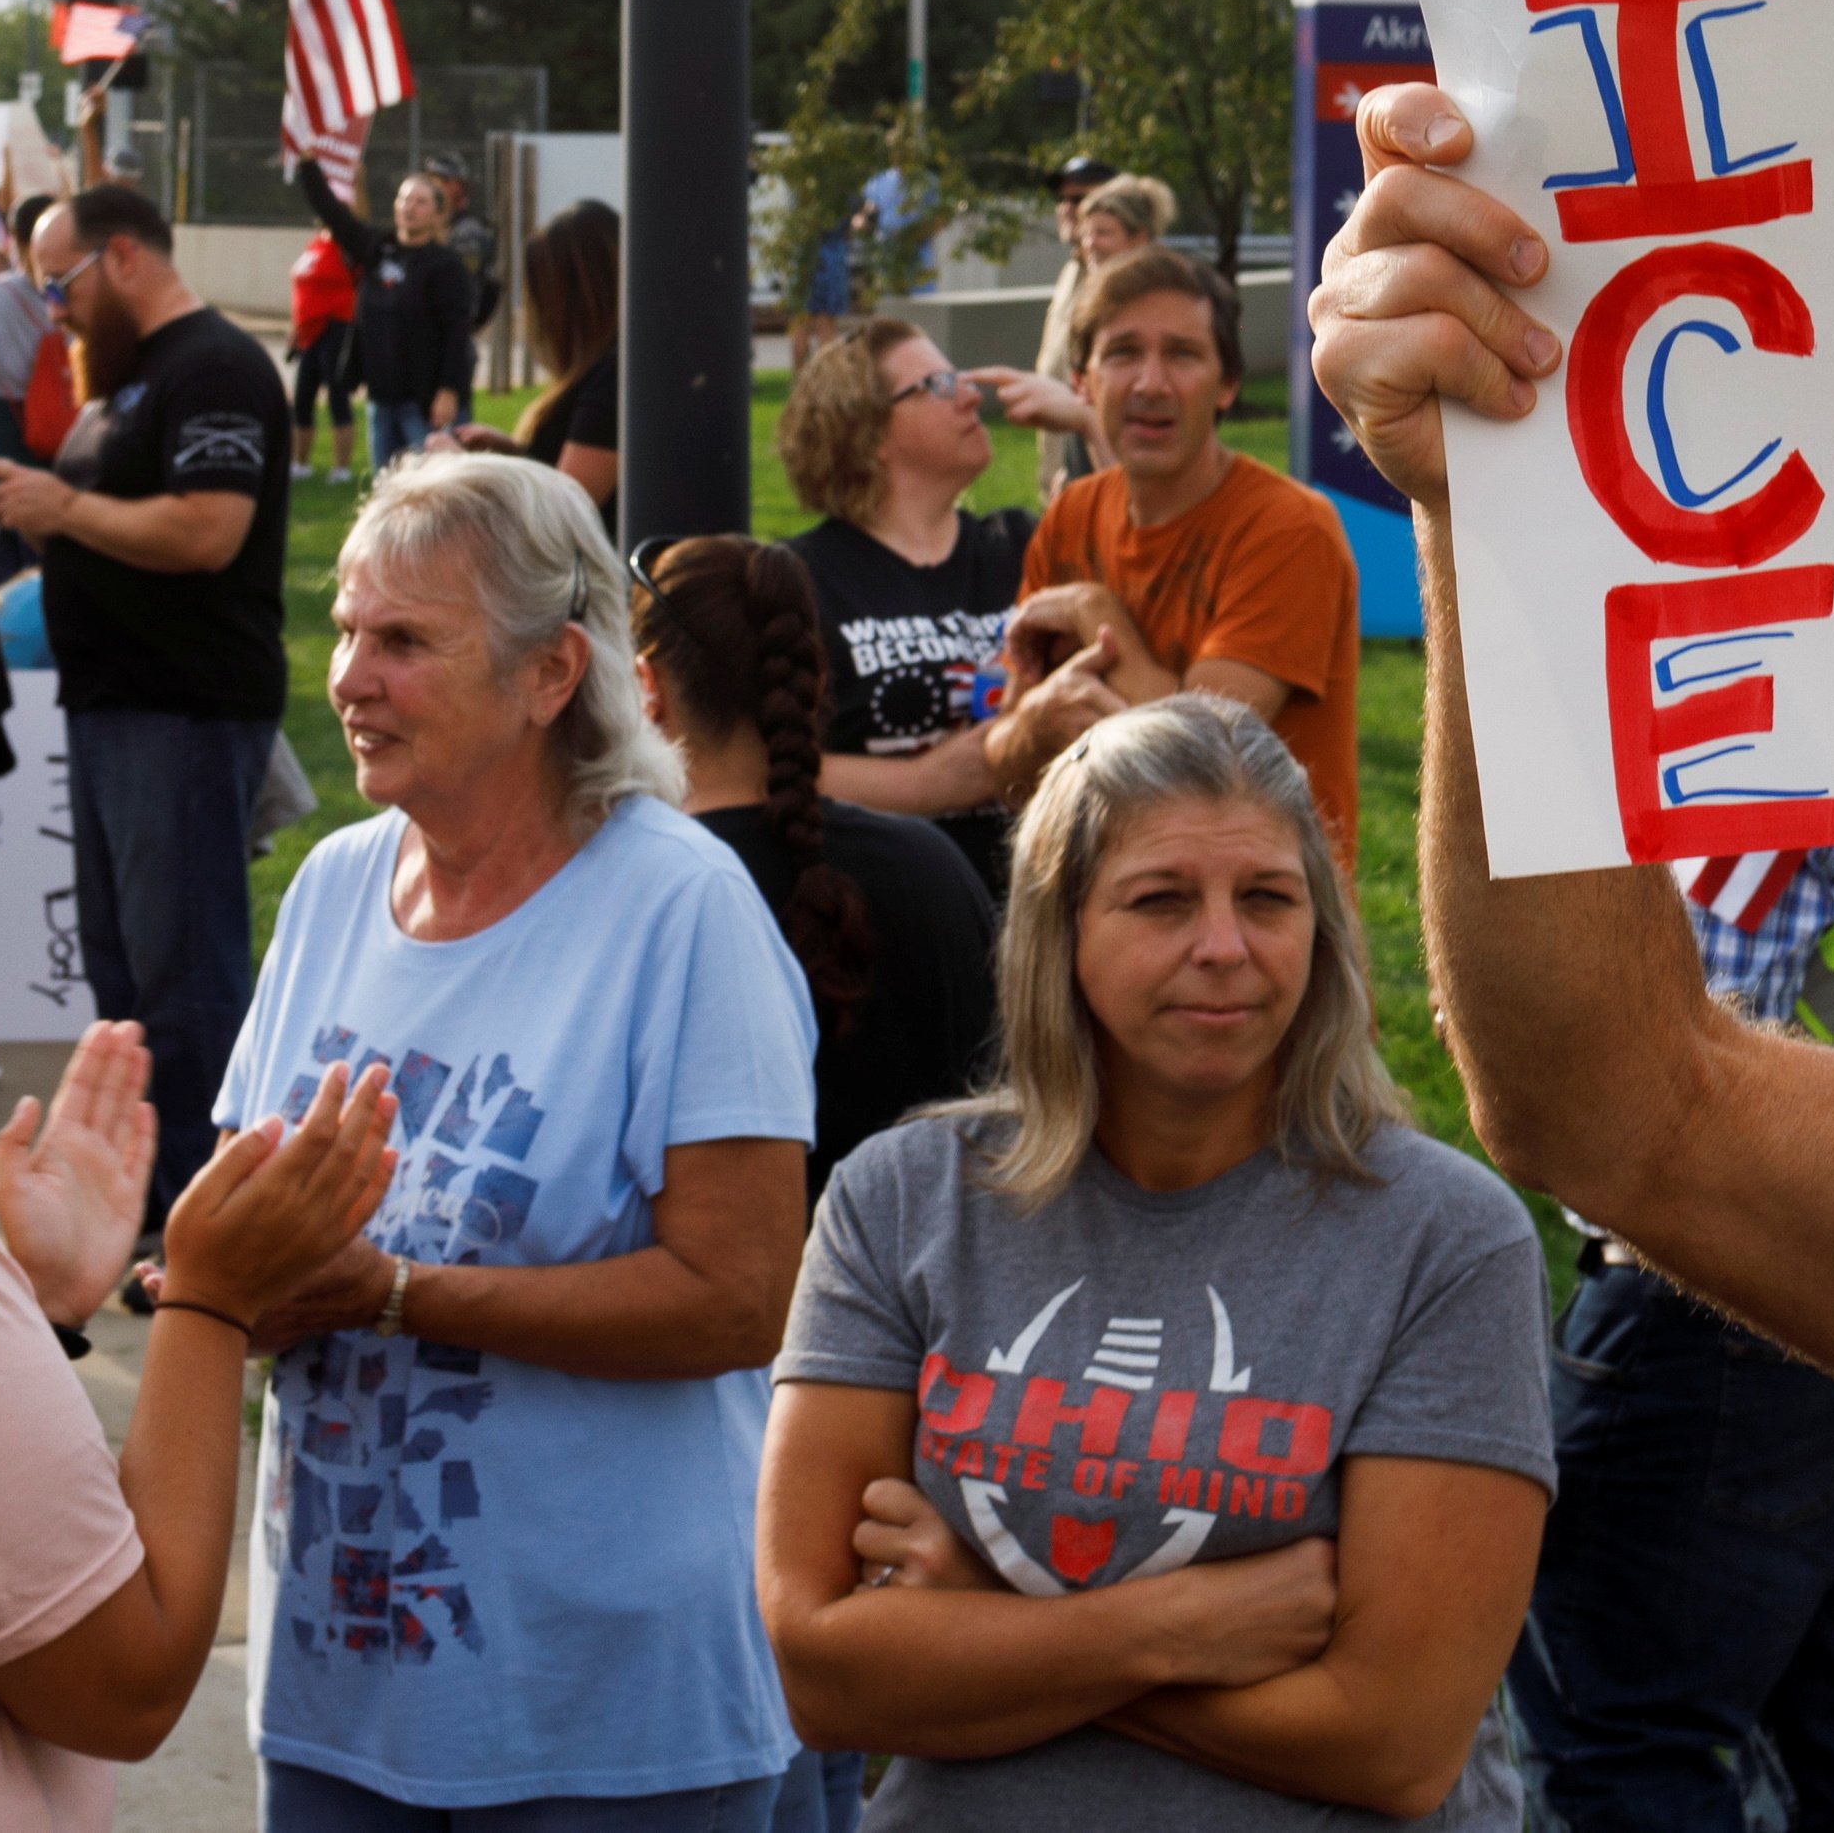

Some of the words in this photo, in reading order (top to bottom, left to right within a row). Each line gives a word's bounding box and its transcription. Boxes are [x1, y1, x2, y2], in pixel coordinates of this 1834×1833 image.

[838, 615, 938, 646] WHEN
[850, 635, 996, 677] BECOM
[918, 1352, 1333, 1476] OHIO
[919, 1429, 1053, 1491] STATE
[1072, 1456, 1141, 1500] OF
[1158, 1464, 1308, 1521] MIND
